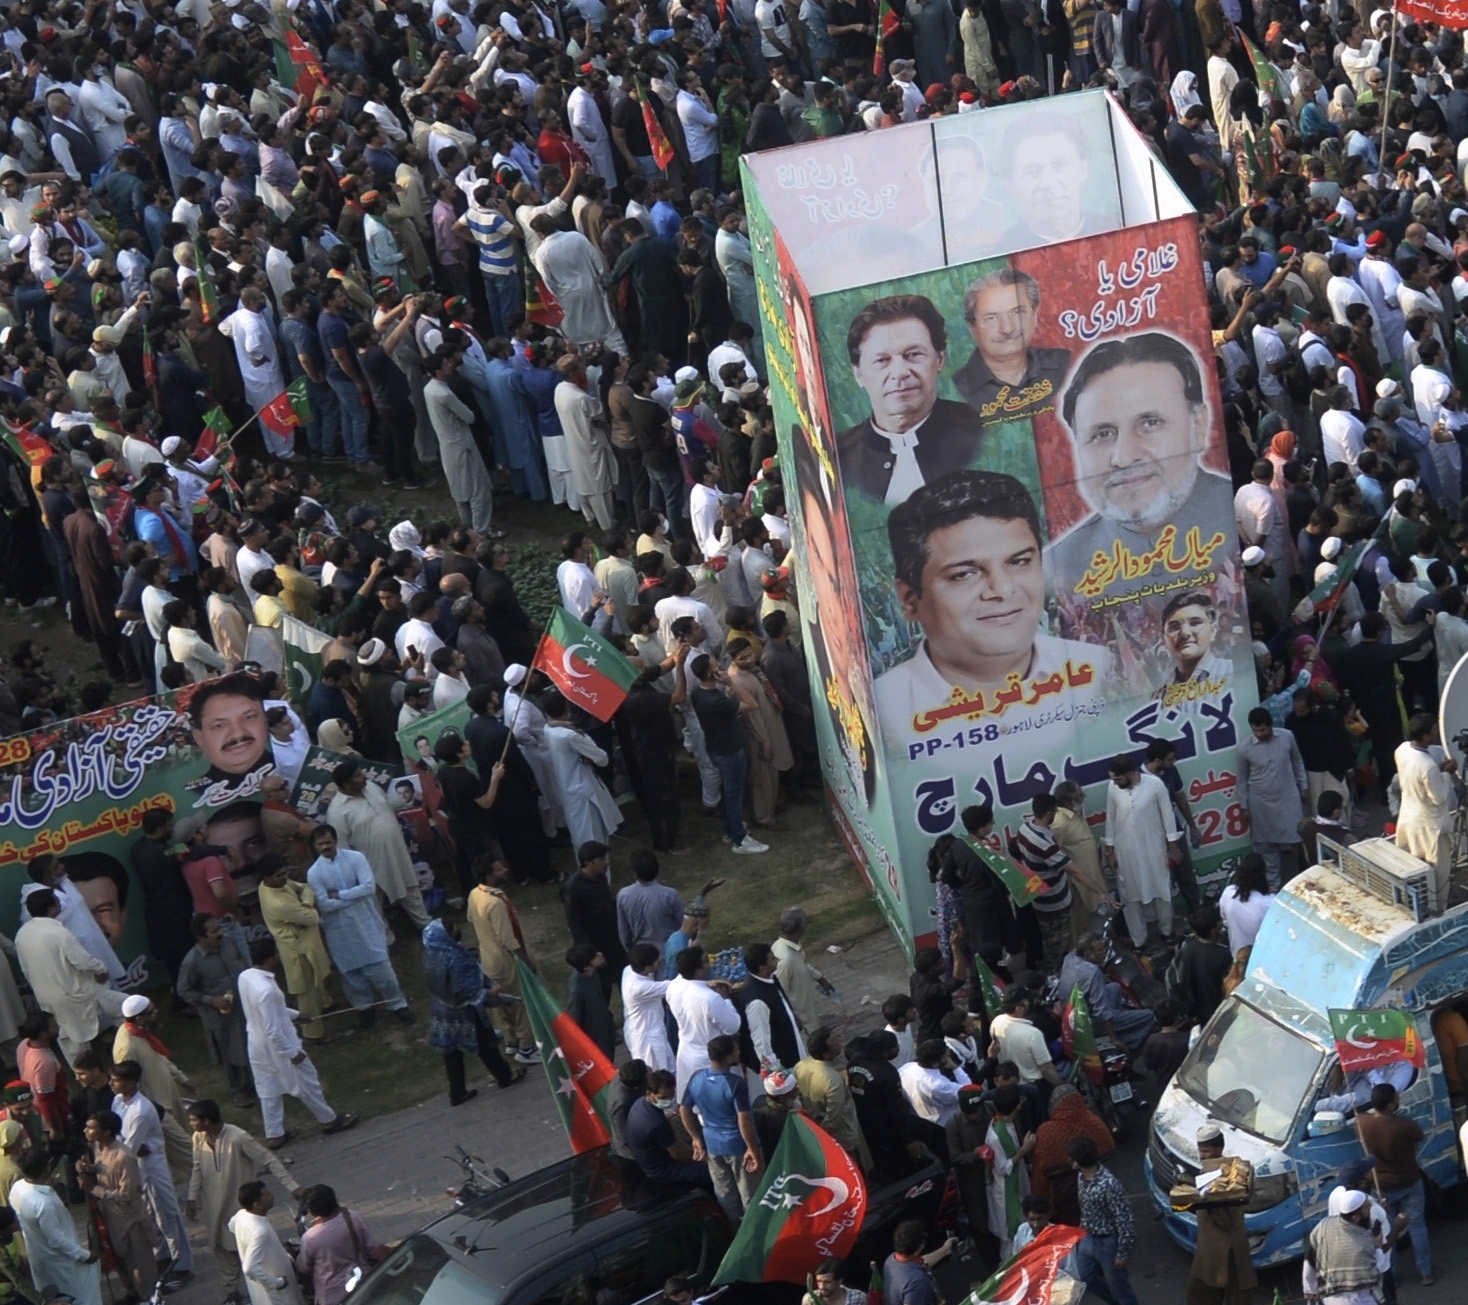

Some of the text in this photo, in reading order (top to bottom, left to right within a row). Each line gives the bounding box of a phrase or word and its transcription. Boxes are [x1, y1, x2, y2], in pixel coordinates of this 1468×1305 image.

[1098, 243, 1179, 296] غلامی یا
[1059, 283, 1162, 342] آزادی؟
[1090, 589, 1140, 611] پنجاب
[582, 634, 603, 653] PTI
[912, 659, 1094, 734] عامر قریشی
[908, 722, 1001, 762] PP-158
[1006, 717, 1033, 736] لاہور
[104, 704, 177, 800] حقیقی
[11, 725, 112, 830] آزادی
[914, 753, 1059, 835] مارچ
[1187, 768, 1238, 804] چلو
[50, 808, 129, 854] پاکستان
[1196, 802, 1251, 848] 28
